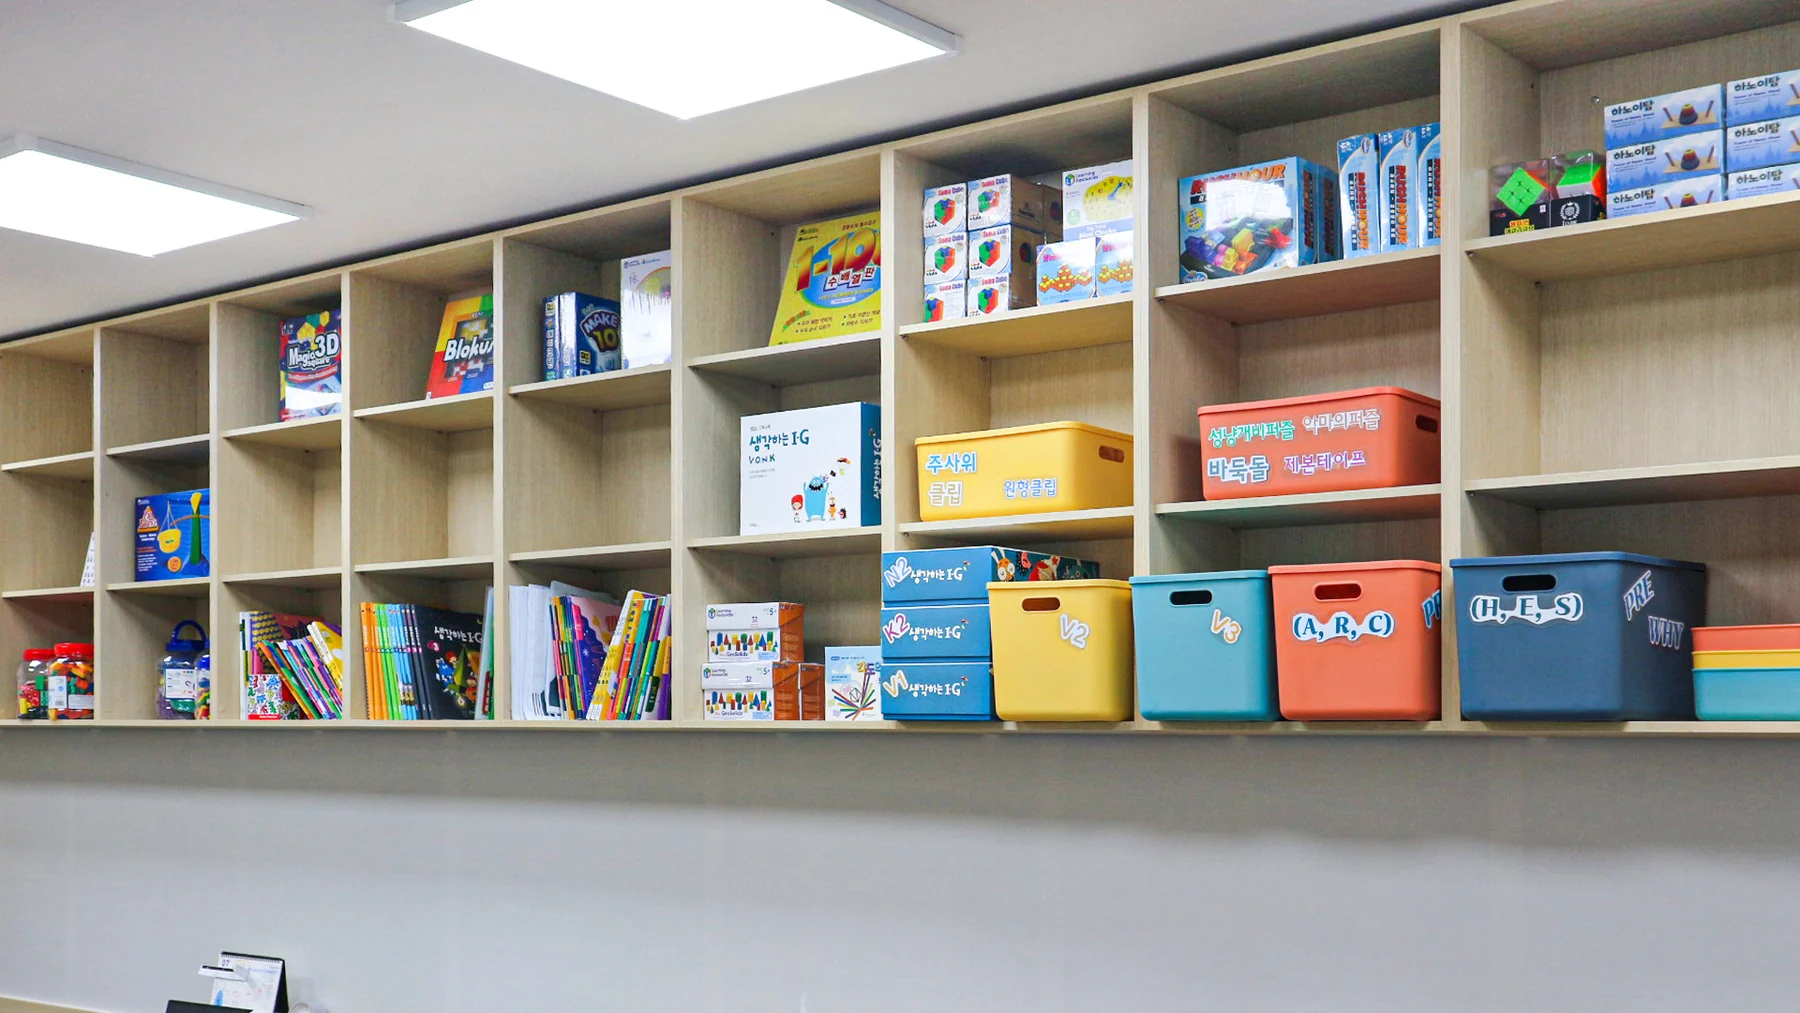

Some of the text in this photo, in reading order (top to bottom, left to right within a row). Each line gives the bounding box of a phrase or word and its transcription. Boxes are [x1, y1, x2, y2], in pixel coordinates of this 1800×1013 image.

[1735, 76, 1780, 91] 하노이탑
[1611, 100, 1654, 116] 하노이탑
[1735, 122, 1781, 138] 하노이탑
[1613, 145, 1656, 160] 하노이탑
[1737, 169, 1783, 184] 하노이탑
[1395, 165, 1408, 245] RUSH HOUR
[1613, 188, 1655, 204] 하노이탑
[1355, 172, 1369, 250] RUSH HOUR
[583, 312, 619, 334] MAKE
[592, 328, 618, 350] 10
[288, 333, 340, 368] Magic 3D
[1302, 409, 1381, 434] 악마의퍼즐
[749, 432, 789, 452] 생각하는
[1208, 420, 1296, 448] 성냥개비퍼즐
[926, 452, 977, 473] 주사위
[1208, 456, 1269, 483] 바둑돌
[1284, 451, 1366, 475] 제본테이프
[929, 482, 962, 505] 클립
[1003, 478, 1057, 498] 원형클립
[884, 557, 911, 587] N2
[910, 567, 945, 585] 생각하는
[1623, 570, 1655, 621] PRE
[434, 626, 467, 641] 생각하는
[883, 613, 910, 643] K2
[909, 624, 943, 641] 생각하는
[1060, 614, 1090, 648] V2
[1211, 609, 1242, 643] V3
[1648, 616, 1684, 650] WHY
[883, 670, 910, 697] V1
[908, 682, 943, 698] 생각하는
